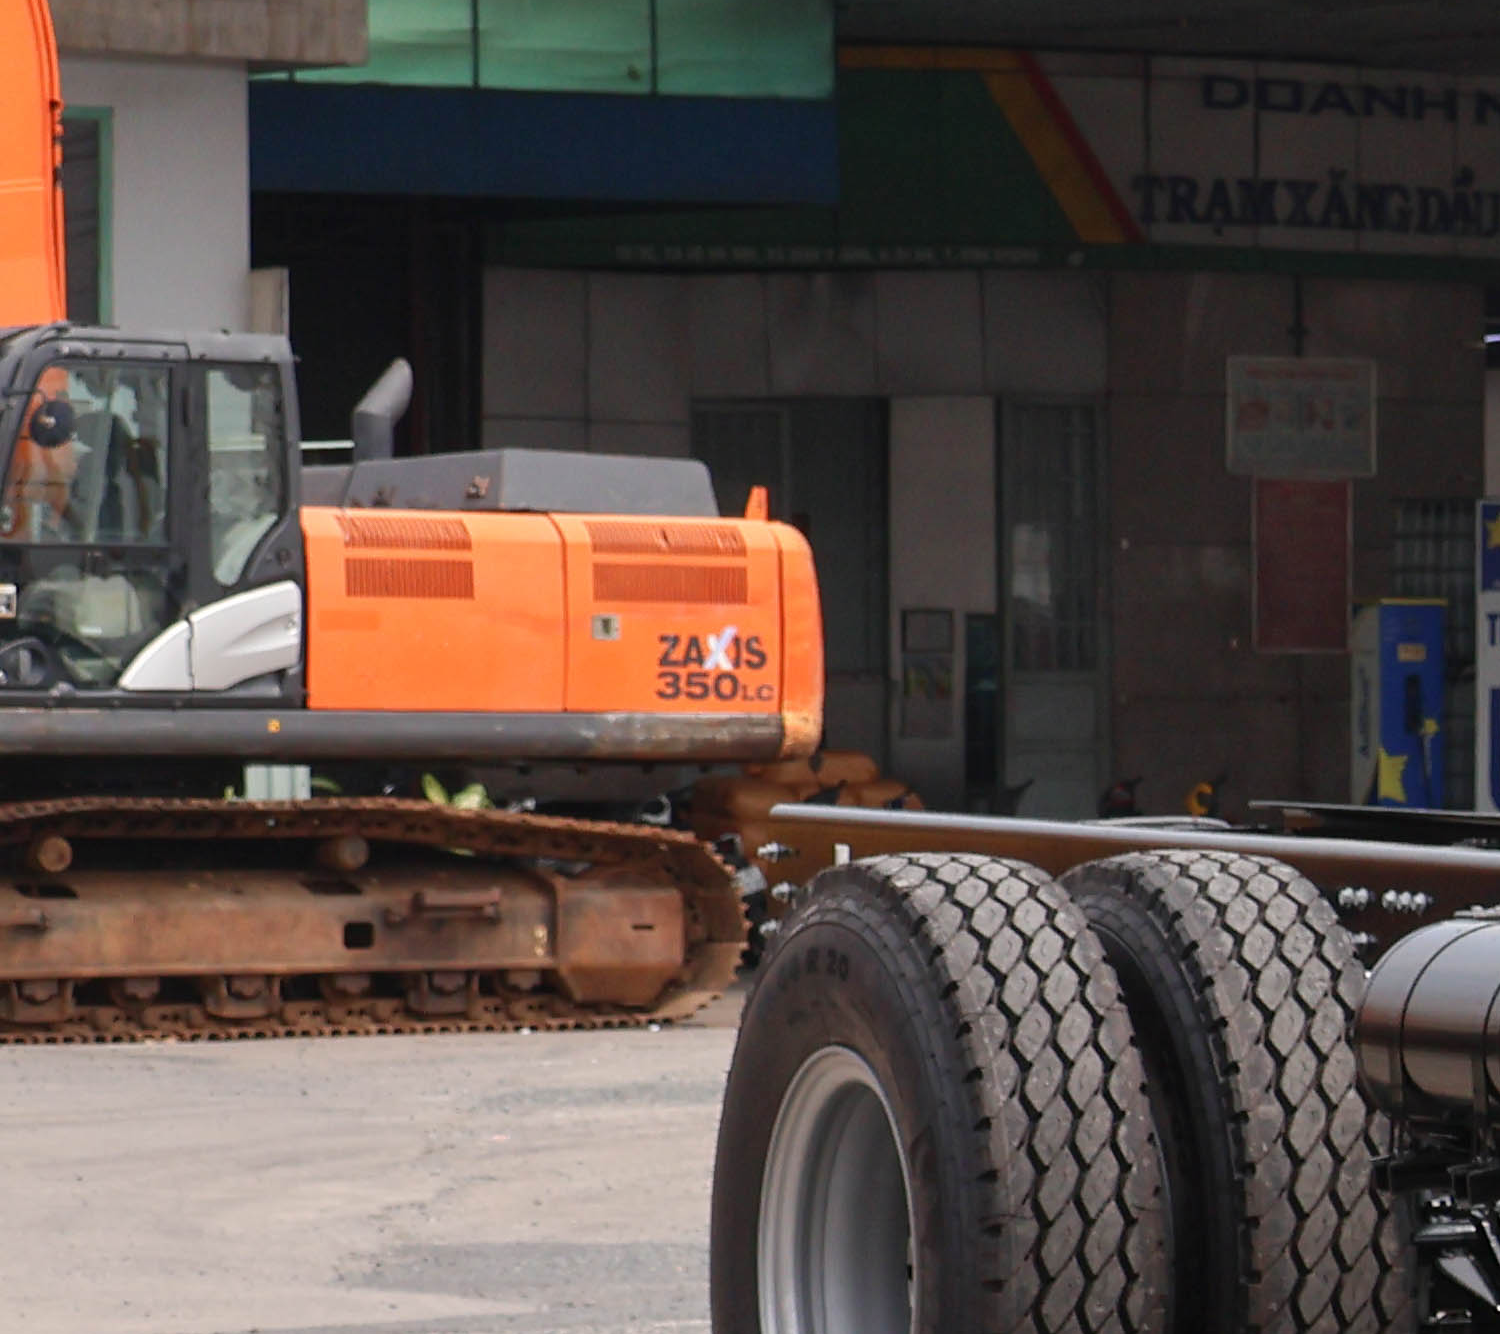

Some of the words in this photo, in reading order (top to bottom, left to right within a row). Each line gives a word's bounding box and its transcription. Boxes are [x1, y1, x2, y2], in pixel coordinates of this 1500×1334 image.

[1203, 75, 1458, 122] DOANH
[1131, 174, 1277, 237] TRẠM
[1278, 169, 1411, 231] XĂNG
[658, 625, 767, 670] ZAXIS
